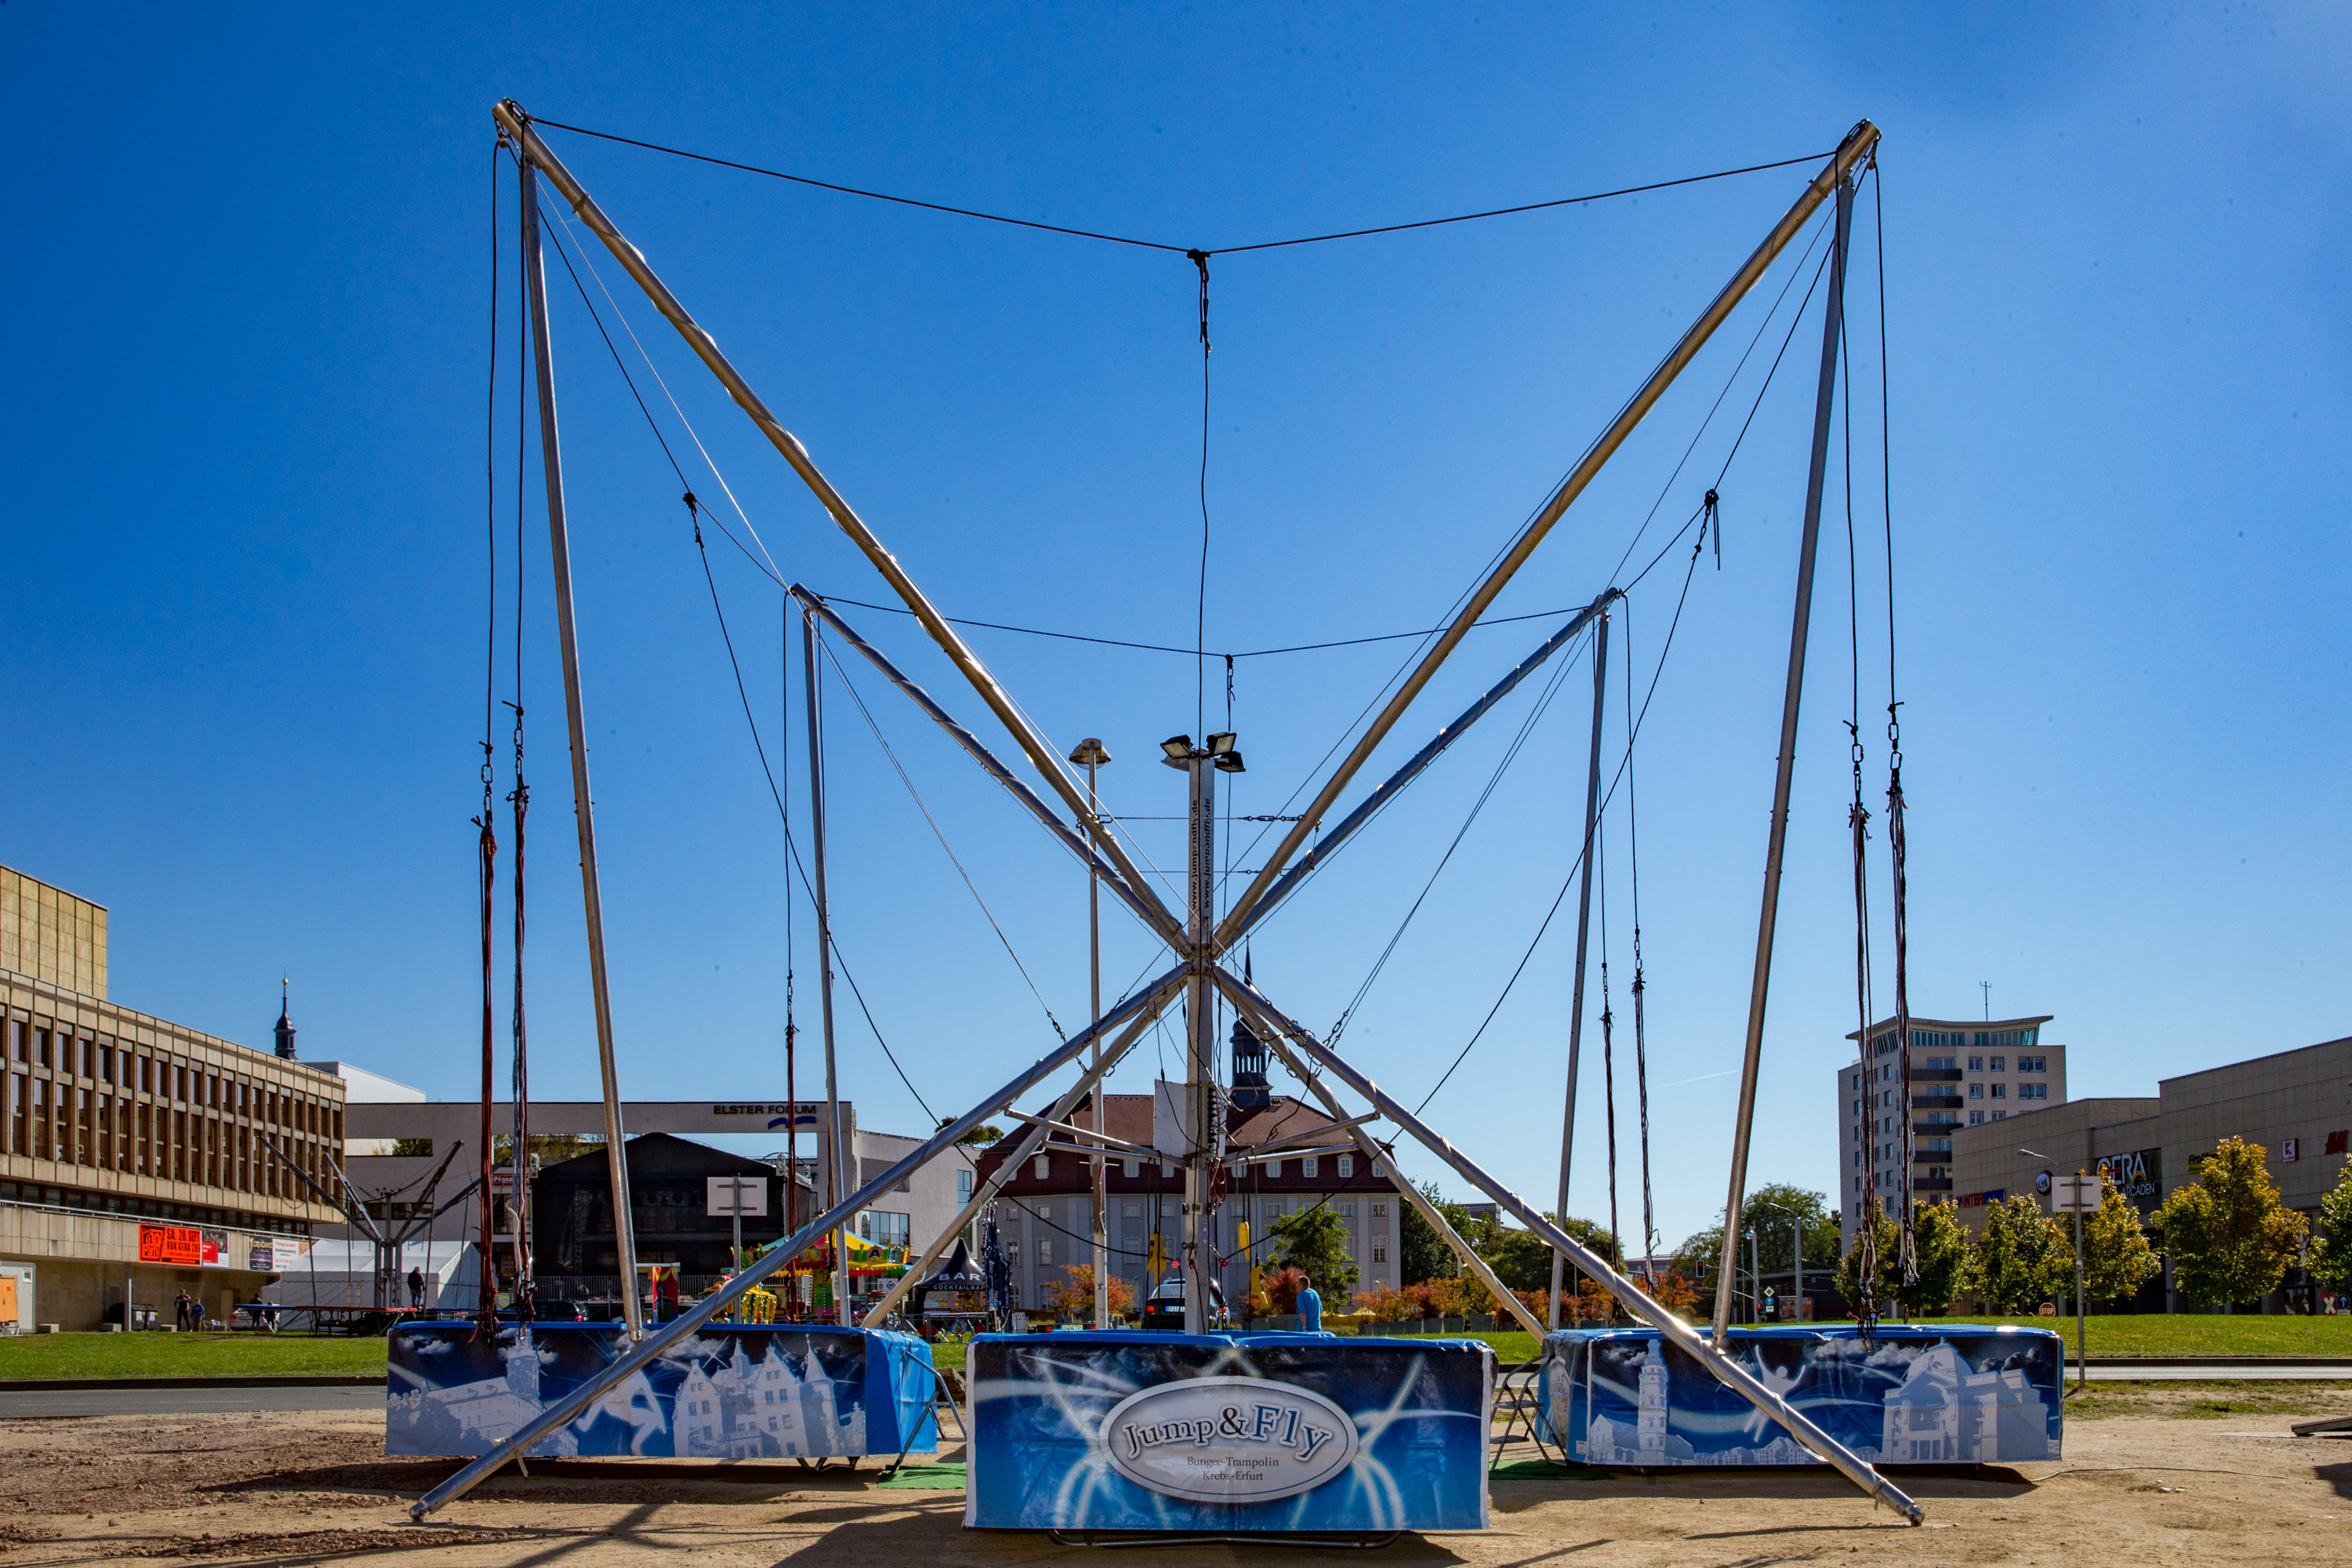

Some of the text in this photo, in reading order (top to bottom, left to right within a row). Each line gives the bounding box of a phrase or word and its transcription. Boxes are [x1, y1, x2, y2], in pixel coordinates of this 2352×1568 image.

[713, 1105, 816, 1114] ELSTER FOUM
[2096, 1152, 2147, 1185] GERA
[2122, 1182, 2155, 1197] ARCADEN
[939, 1272, 981, 1281] BAR
[1124, 1404, 1330, 1459] Jump&Fly
[1187, 1456, 1279, 1468] Bungee-Trampolin
[1203, 1471, 1264, 1481] Krebs-Erfurt
